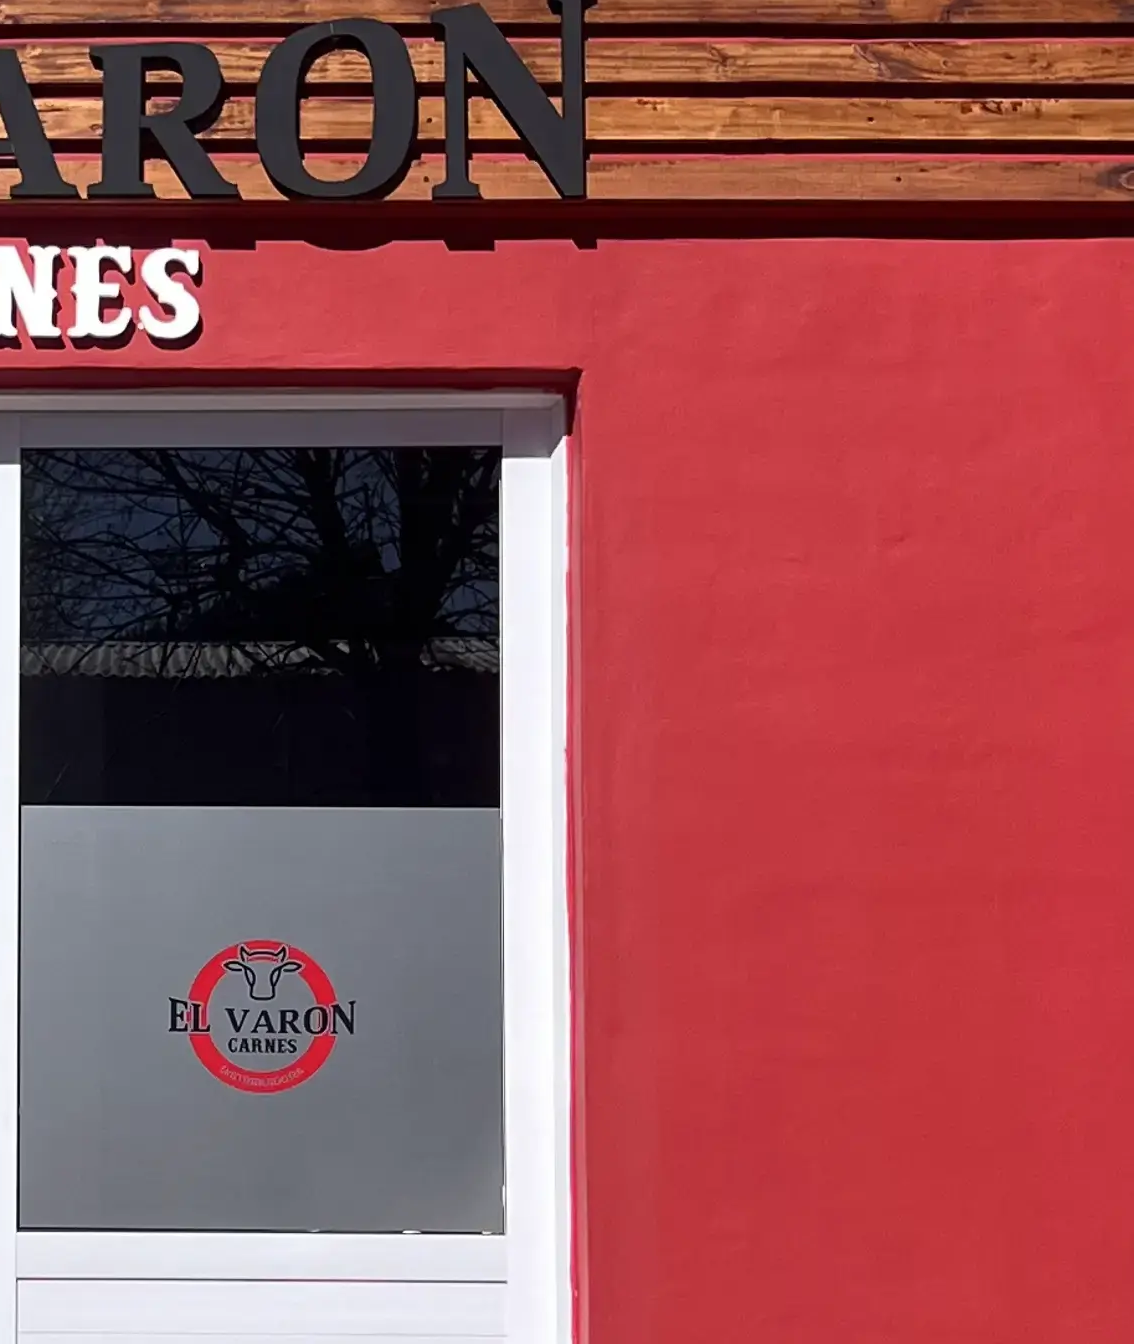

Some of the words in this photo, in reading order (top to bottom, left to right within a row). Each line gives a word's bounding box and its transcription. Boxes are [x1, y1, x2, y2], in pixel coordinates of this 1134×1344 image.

[168, 996, 211, 1032] EL
[224, 1000, 357, 1035] VARON
[227, 1038, 298, 1054] CARNES
